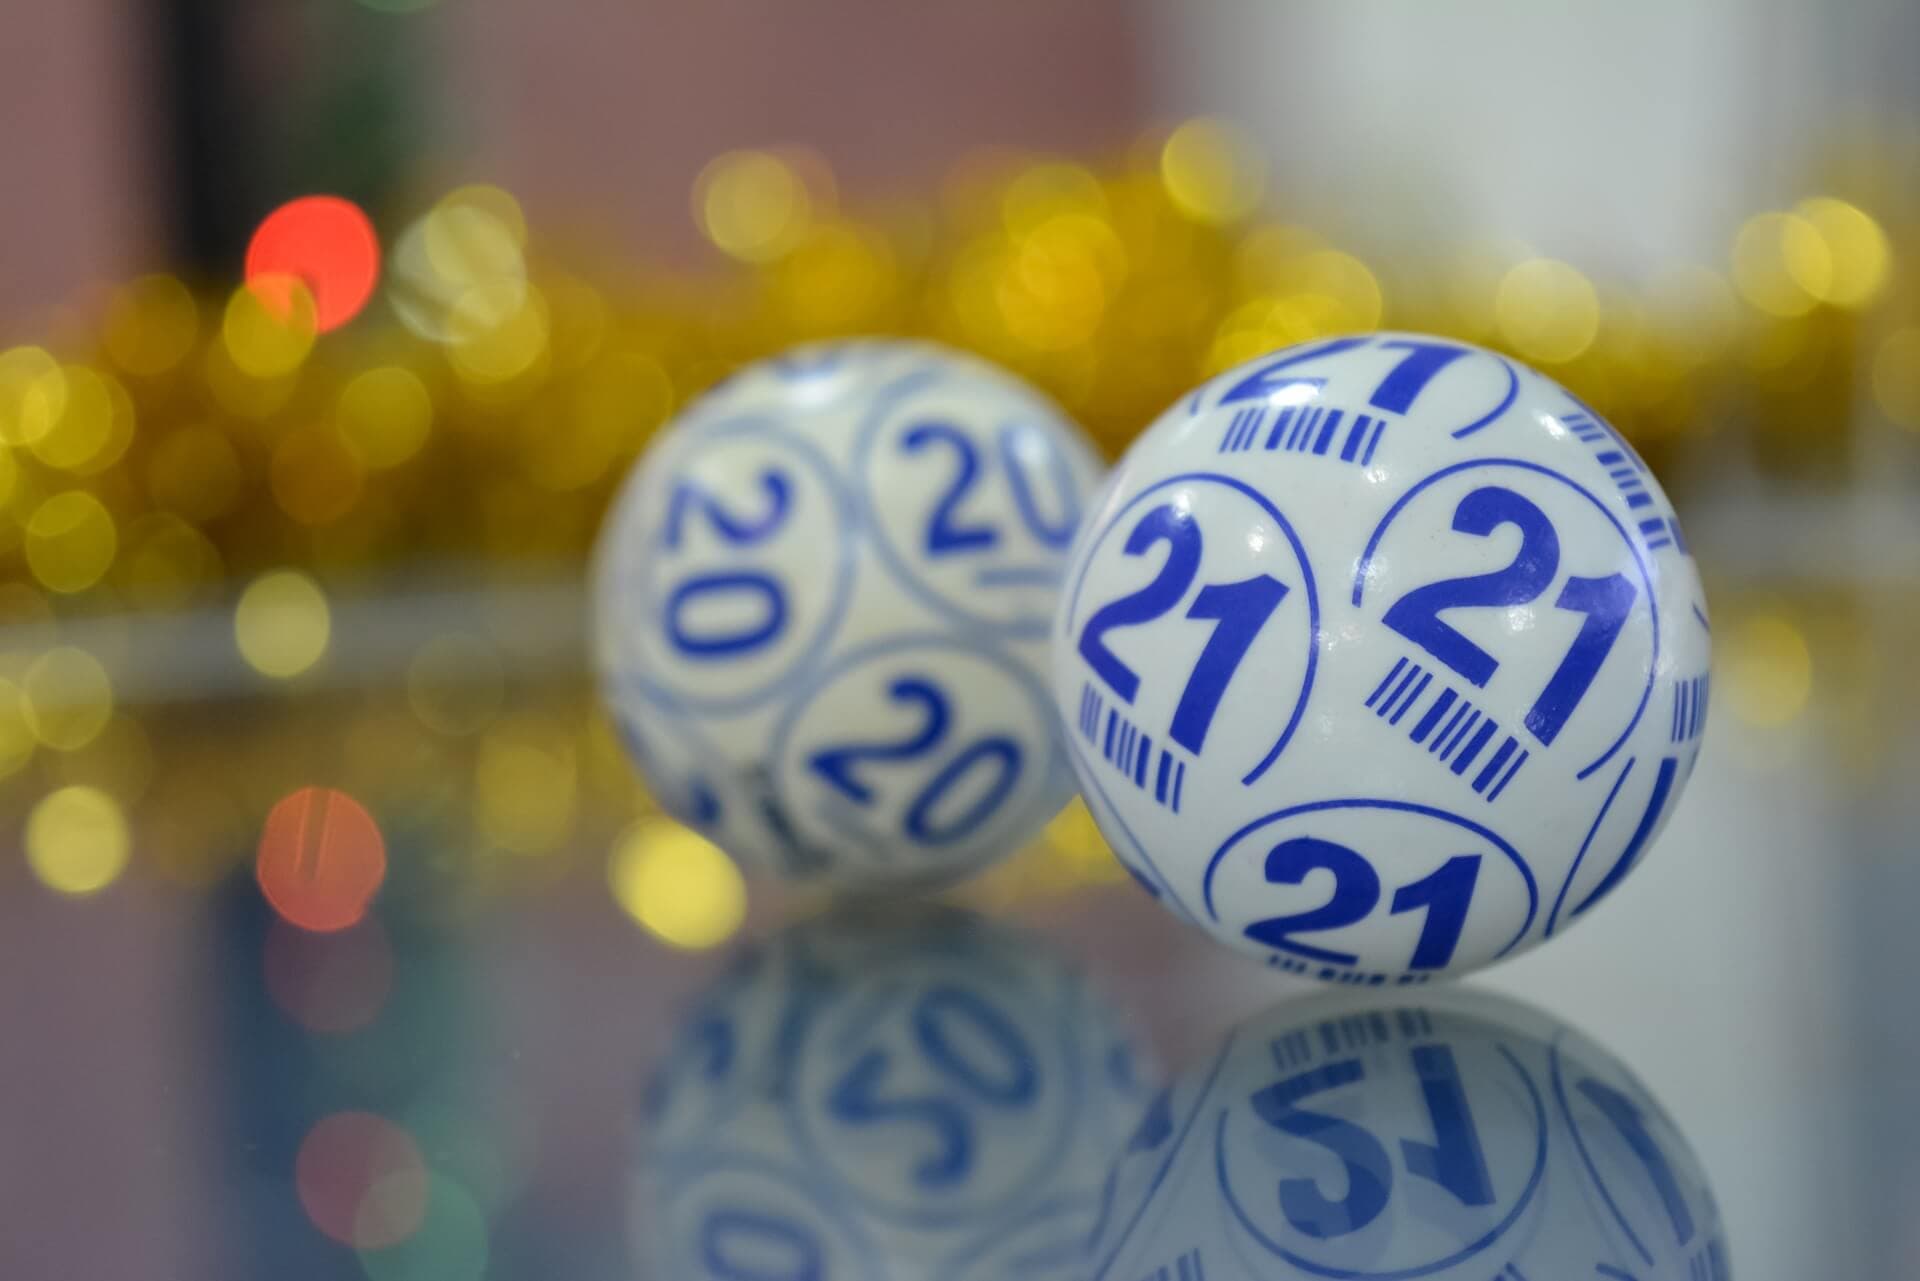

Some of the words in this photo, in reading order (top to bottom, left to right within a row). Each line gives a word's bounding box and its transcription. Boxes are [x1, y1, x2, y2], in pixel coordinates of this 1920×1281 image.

[664, 467, 794, 661] 20
[900, 422, 1082, 556] 20
[1078, 504, 1290, 757] 21
[1381, 486, 1638, 748] 21
[809, 677, 1023, 848] 20
[1243, 837, 1483, 971] 21
